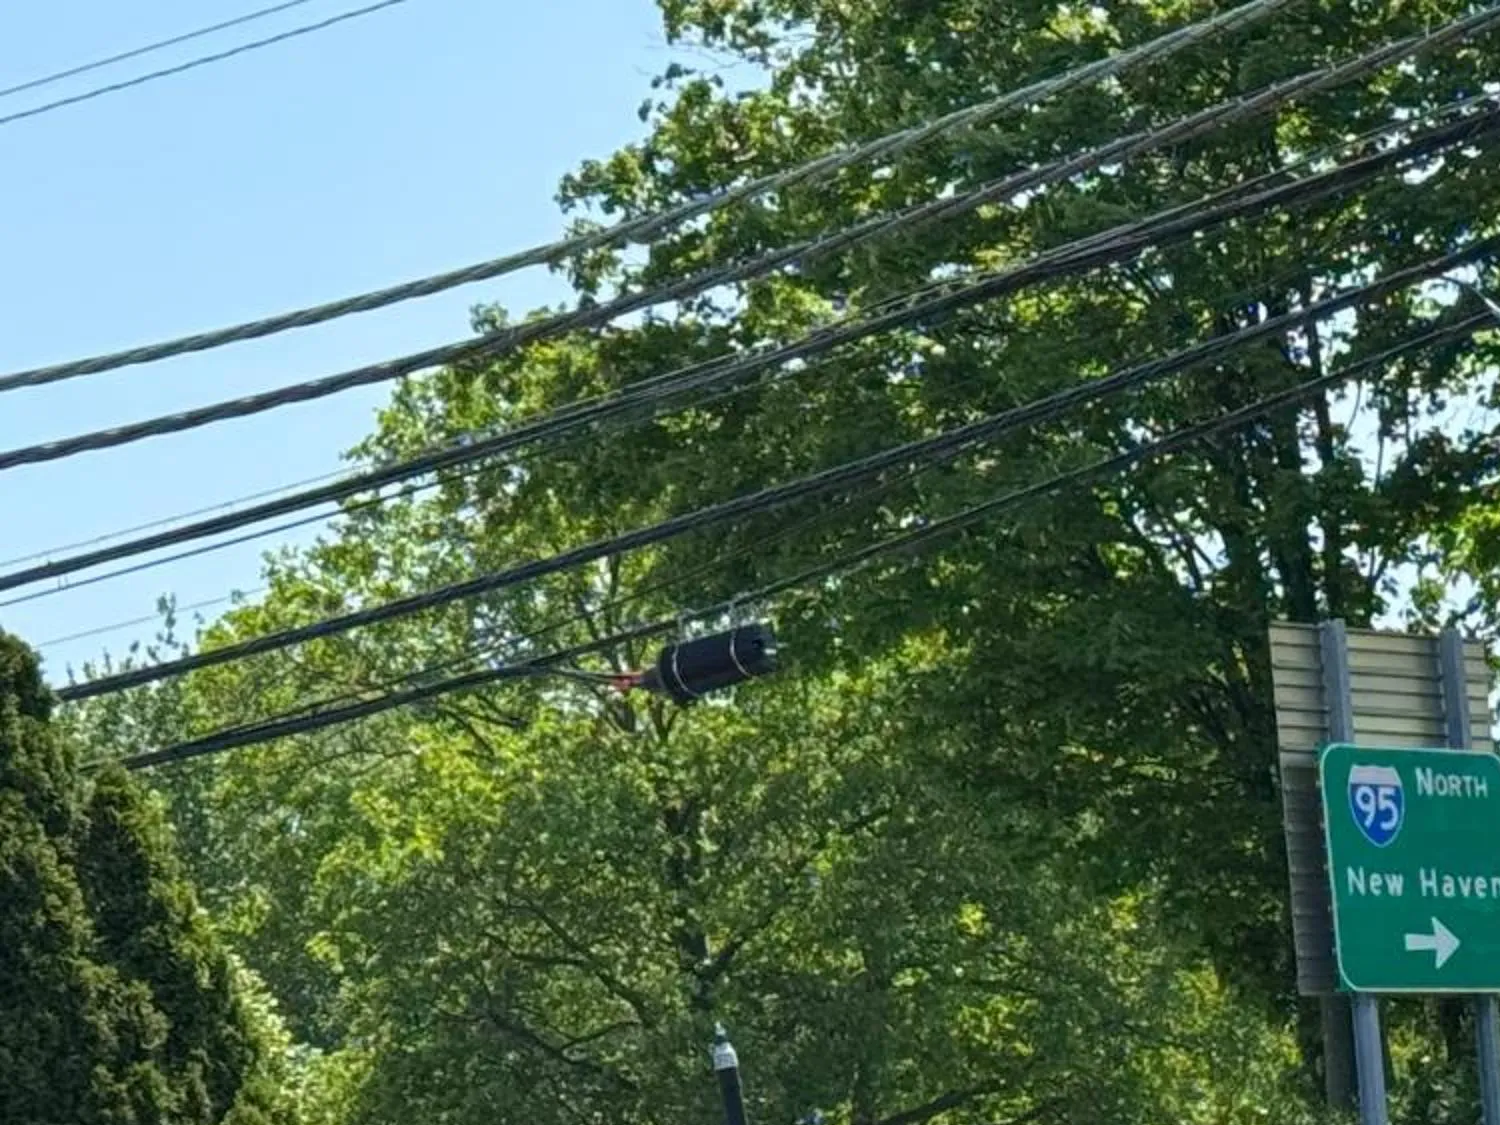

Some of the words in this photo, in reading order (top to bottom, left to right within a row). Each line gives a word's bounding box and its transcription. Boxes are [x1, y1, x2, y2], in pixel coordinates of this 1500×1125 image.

[1415, 766, 1489, 798] NORTH
[1354, 785, 1400, 832] 95
[1346, 866, 1404, 897] New
